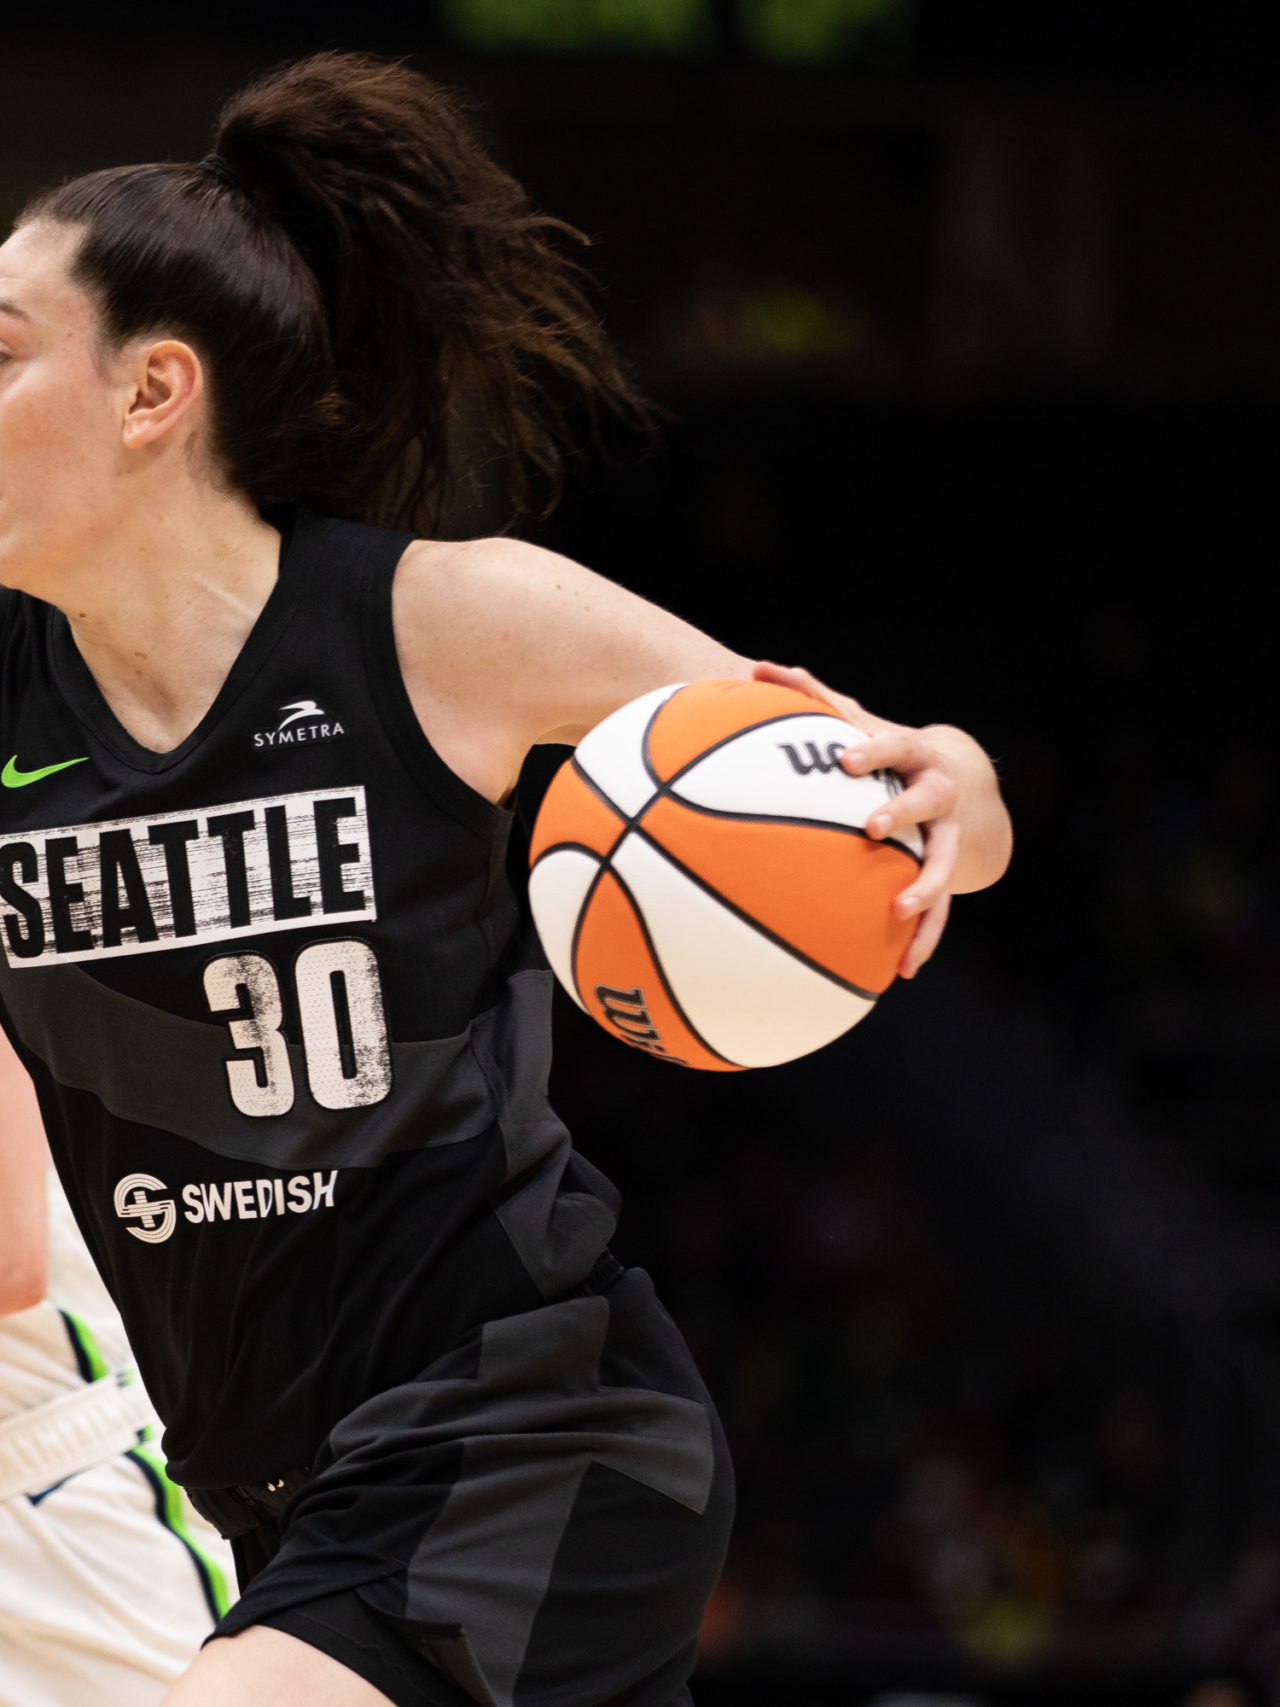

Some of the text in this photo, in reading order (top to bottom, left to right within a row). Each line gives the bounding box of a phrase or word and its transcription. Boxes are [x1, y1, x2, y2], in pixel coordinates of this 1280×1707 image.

[253, 721, 345, 748] SYMETRA
[202, 939, 394, 1119] 30
[182, 1170, 338, 1224] SWEDISH
